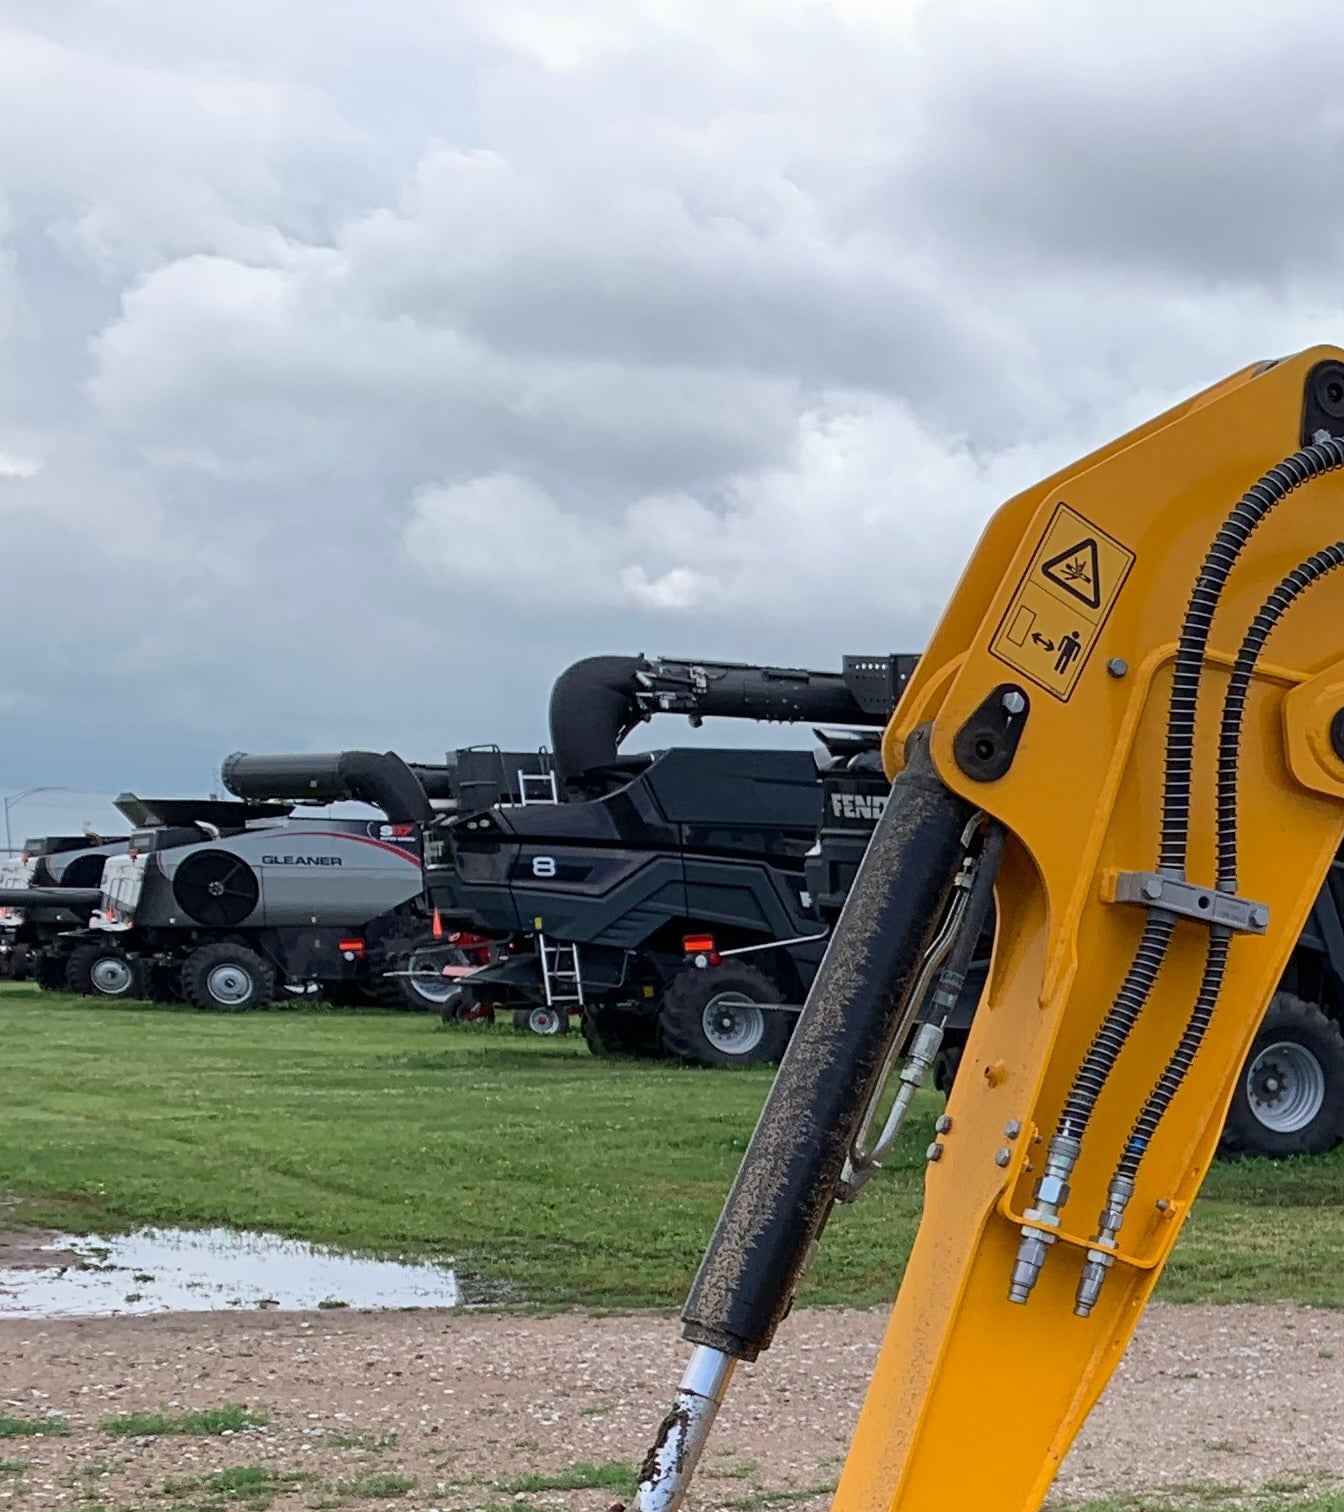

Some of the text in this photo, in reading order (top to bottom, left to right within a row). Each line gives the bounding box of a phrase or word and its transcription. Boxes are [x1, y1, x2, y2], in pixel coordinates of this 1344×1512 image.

[831, 793, 889, 819] FEND
[262, 855, 342, 866] GLEANER
[533, 856, 556, 877] 8
